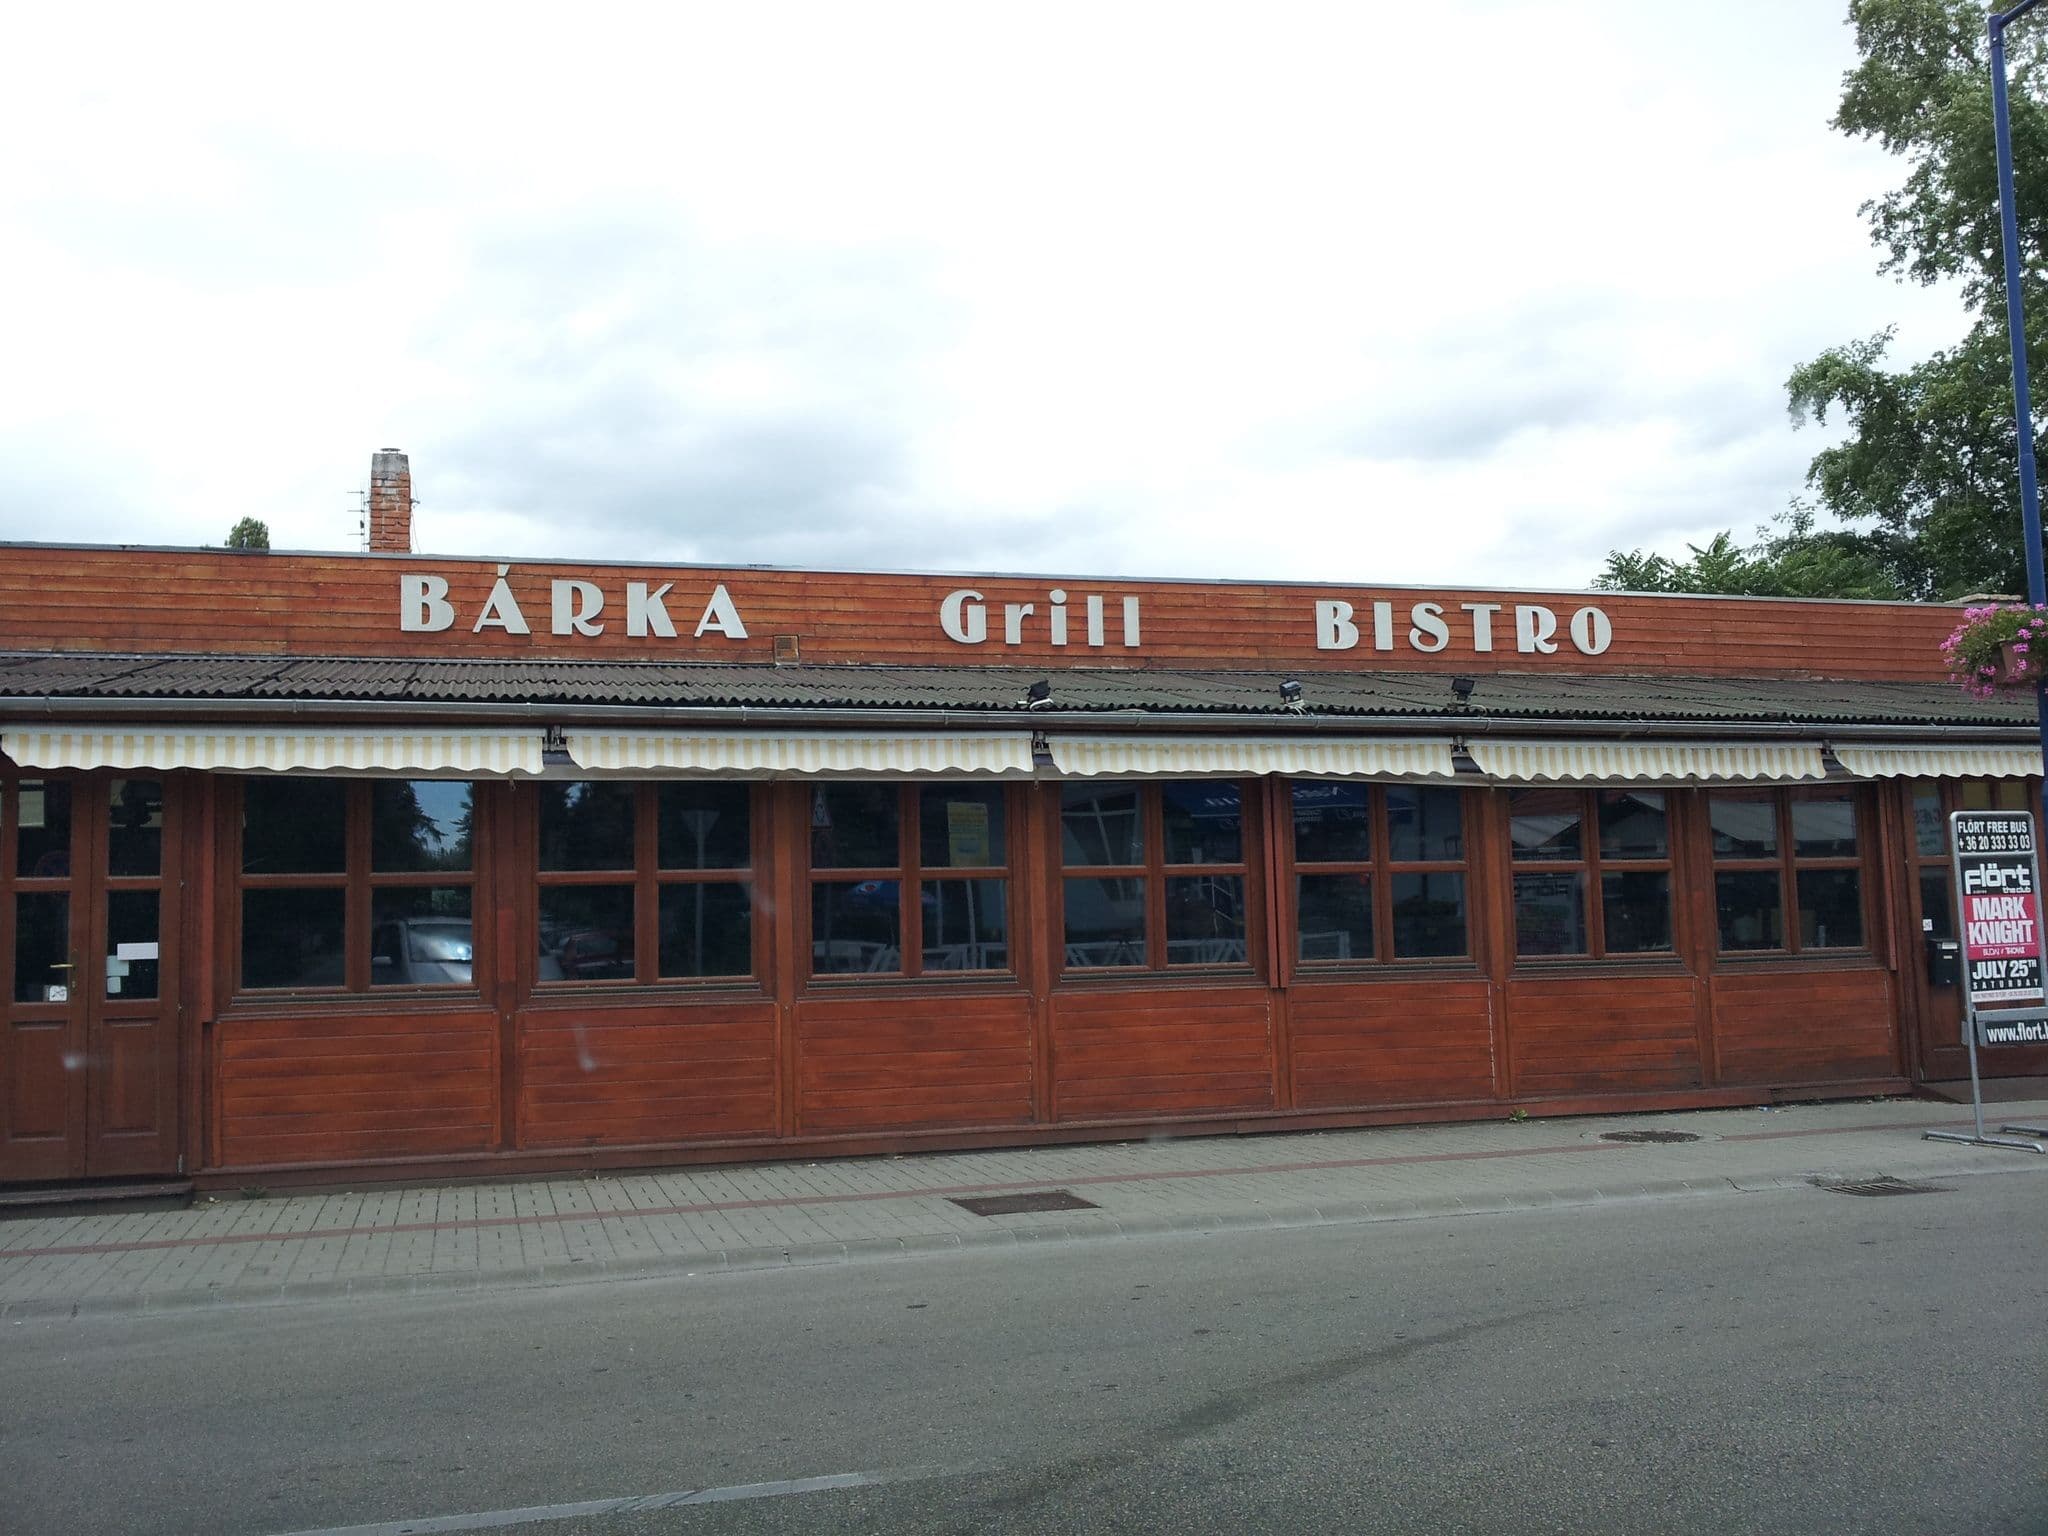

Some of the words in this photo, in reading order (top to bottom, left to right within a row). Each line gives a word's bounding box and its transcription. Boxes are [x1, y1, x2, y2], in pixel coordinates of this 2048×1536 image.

[400, 564, 748, 639] BÁRKA
[940, 589, 1140, 647] Grill
[1316, 600, 1612, 656] BISTRO
[1987, 821, 2009, 833] FREE
[2010, 821, 2028, 833] BUS
[1966, 835, 1977, 850] 36
[1978, 835, 1989, 850] 20
[1991, 835, 2007, 850] 333
[2008, 834, 2019, 849] 33
[2020, 834, 2031, 849] 03
[1972, 897, 2027, 920] MARK
[1968, 920, 2034, 945] KNIGHT
[1972, 960, 2007, 980] JULY
[1973, 978, 2039, 990] SATURDAY
